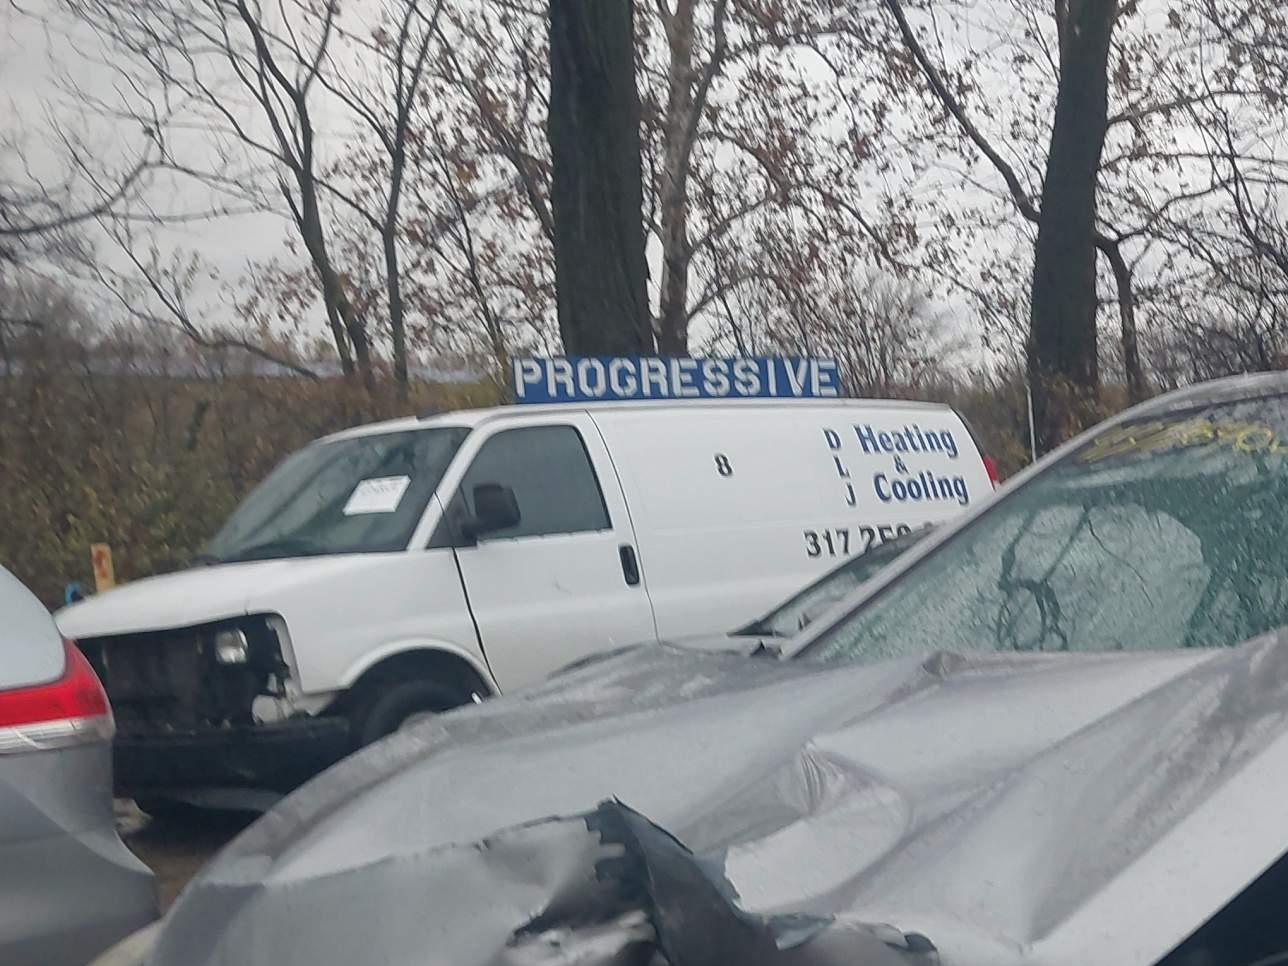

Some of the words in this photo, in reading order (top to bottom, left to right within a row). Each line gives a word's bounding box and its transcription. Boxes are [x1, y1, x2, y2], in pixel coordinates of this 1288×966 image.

[513, 358, 838, 397] PROGRESSIVE
[852, 424, 959, 458] Heating
[714, 453, 734, 477] 8
[893, 454, 909, 474] &
[873, 469, 969, 506] Cooling
[804, 527, 849, 557] 317
